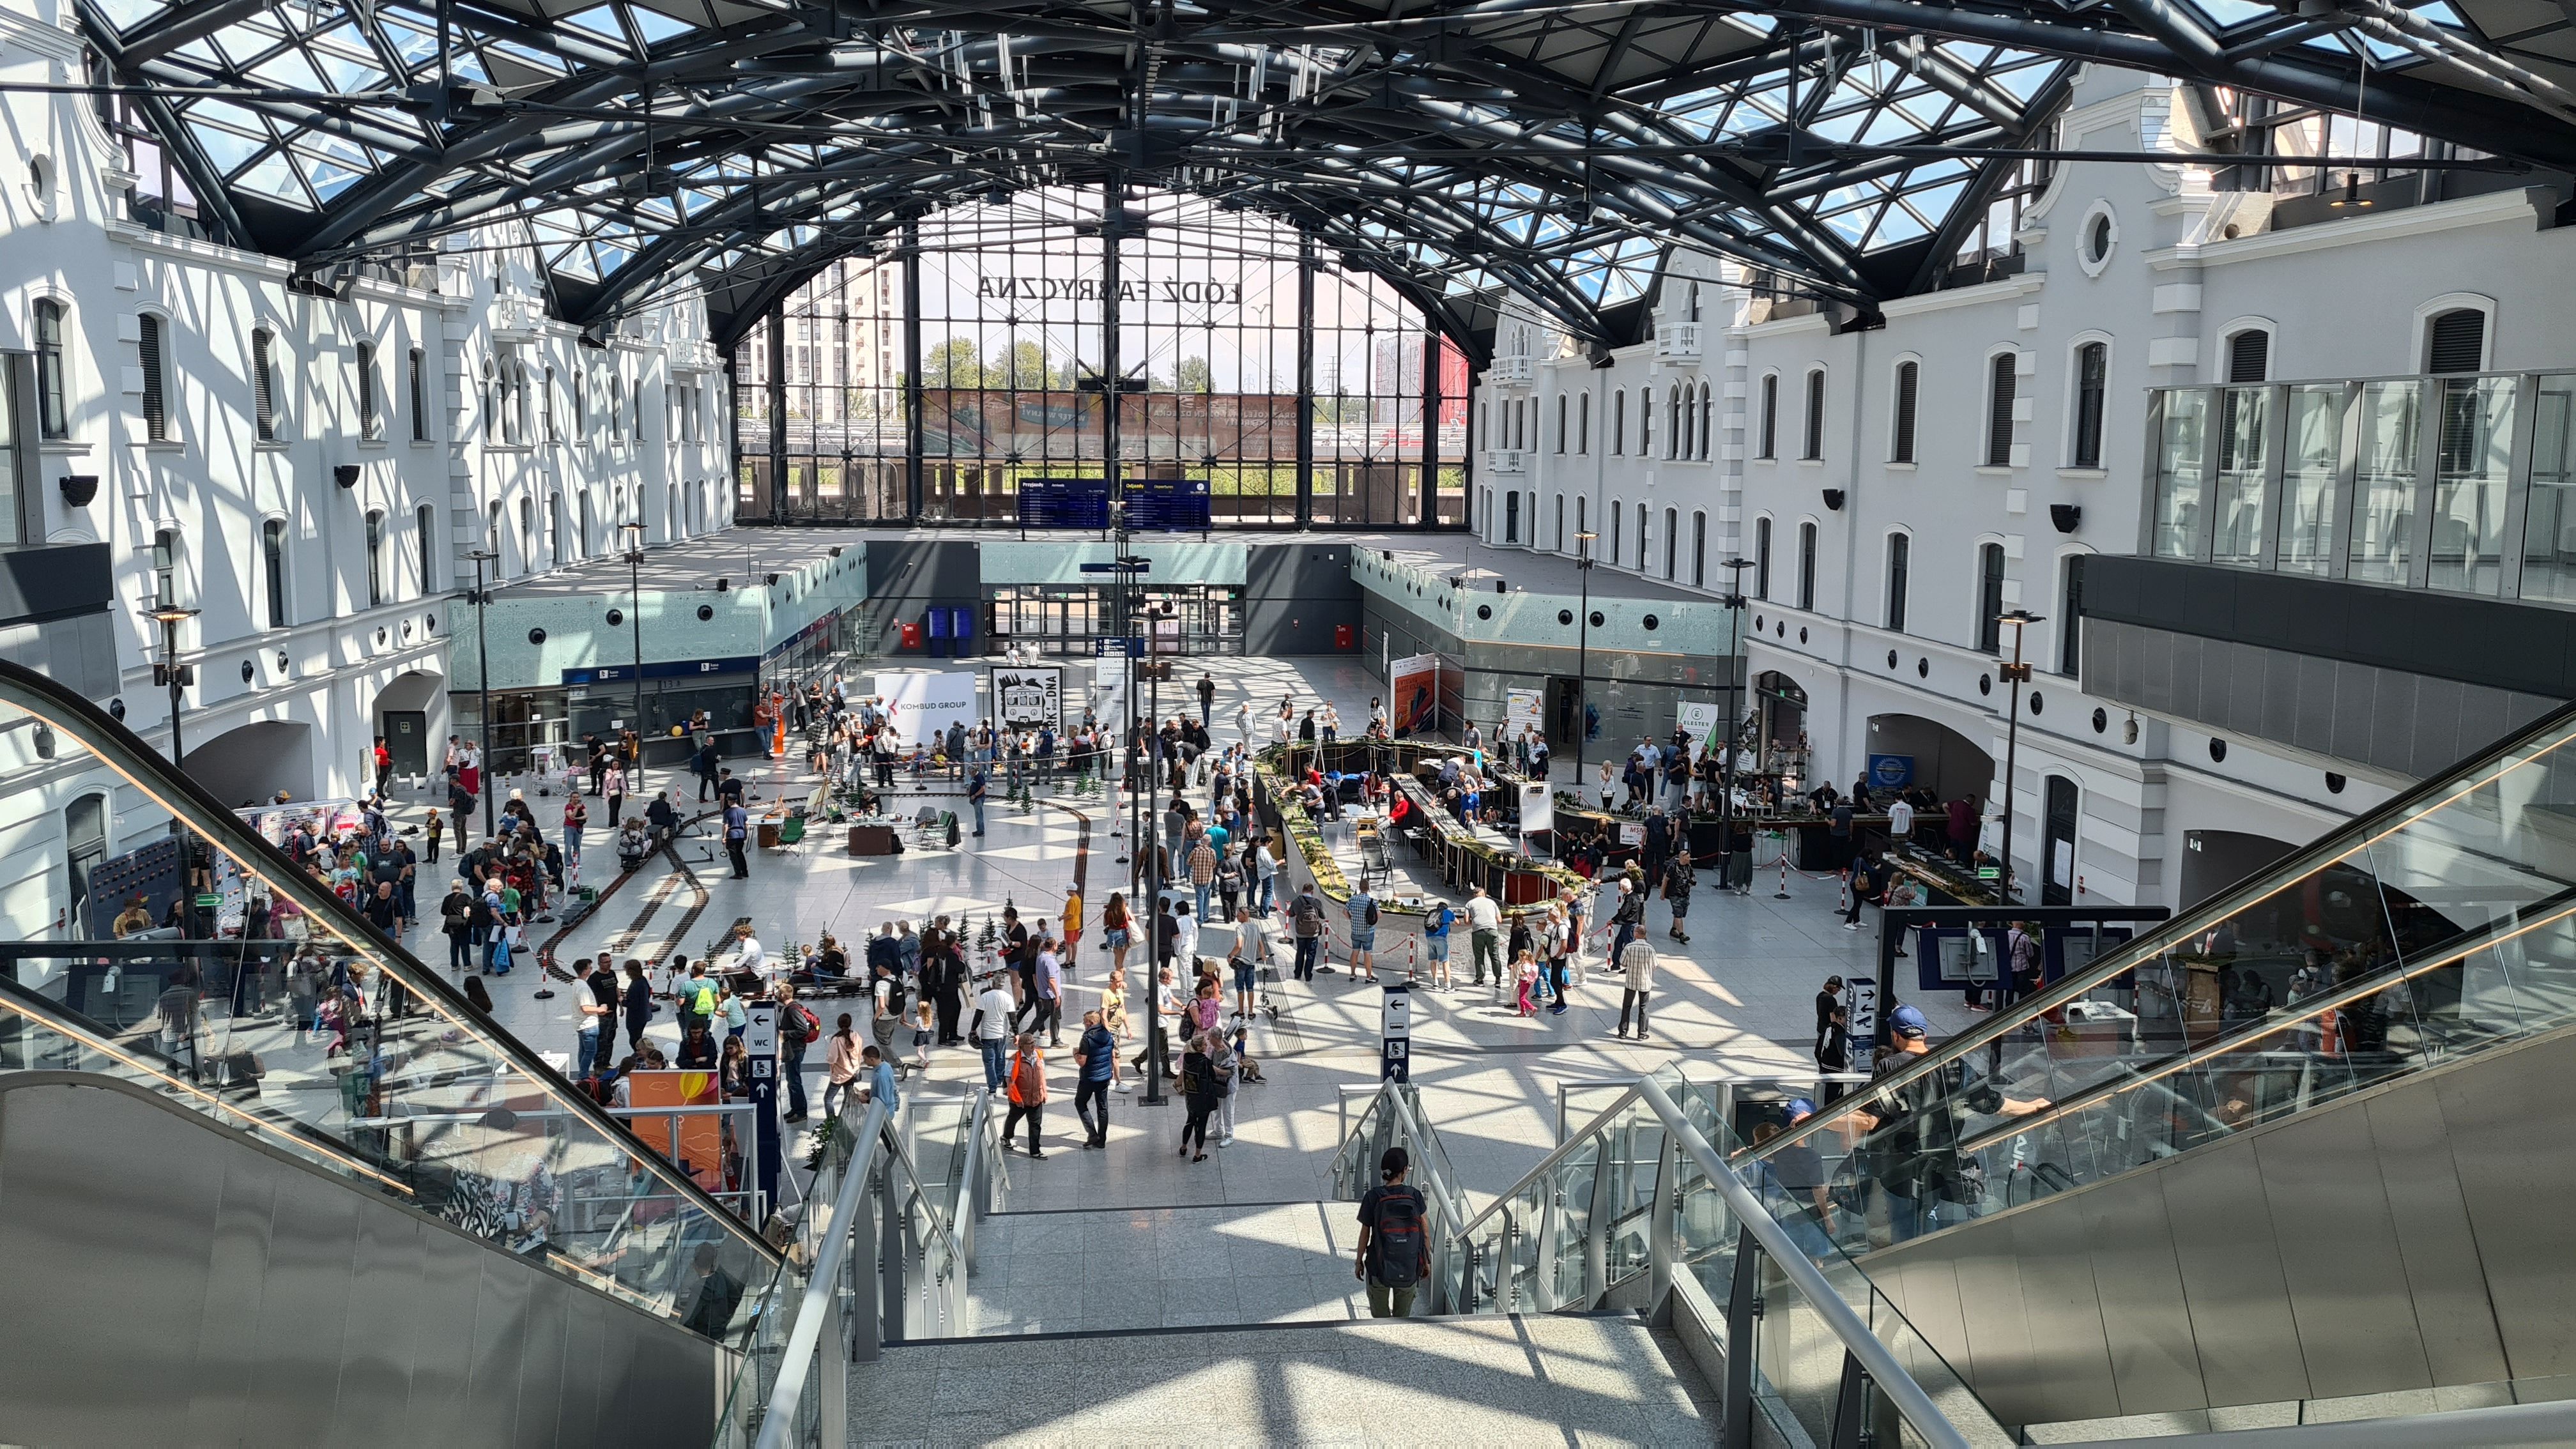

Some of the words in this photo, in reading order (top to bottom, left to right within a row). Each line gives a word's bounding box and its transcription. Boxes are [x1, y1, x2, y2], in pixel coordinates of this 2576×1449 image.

[1045, 676, 1057, 698] DNA
[900, 702, 937, 710] KOMBUD
[938, 701, 967, 709] GROUP
